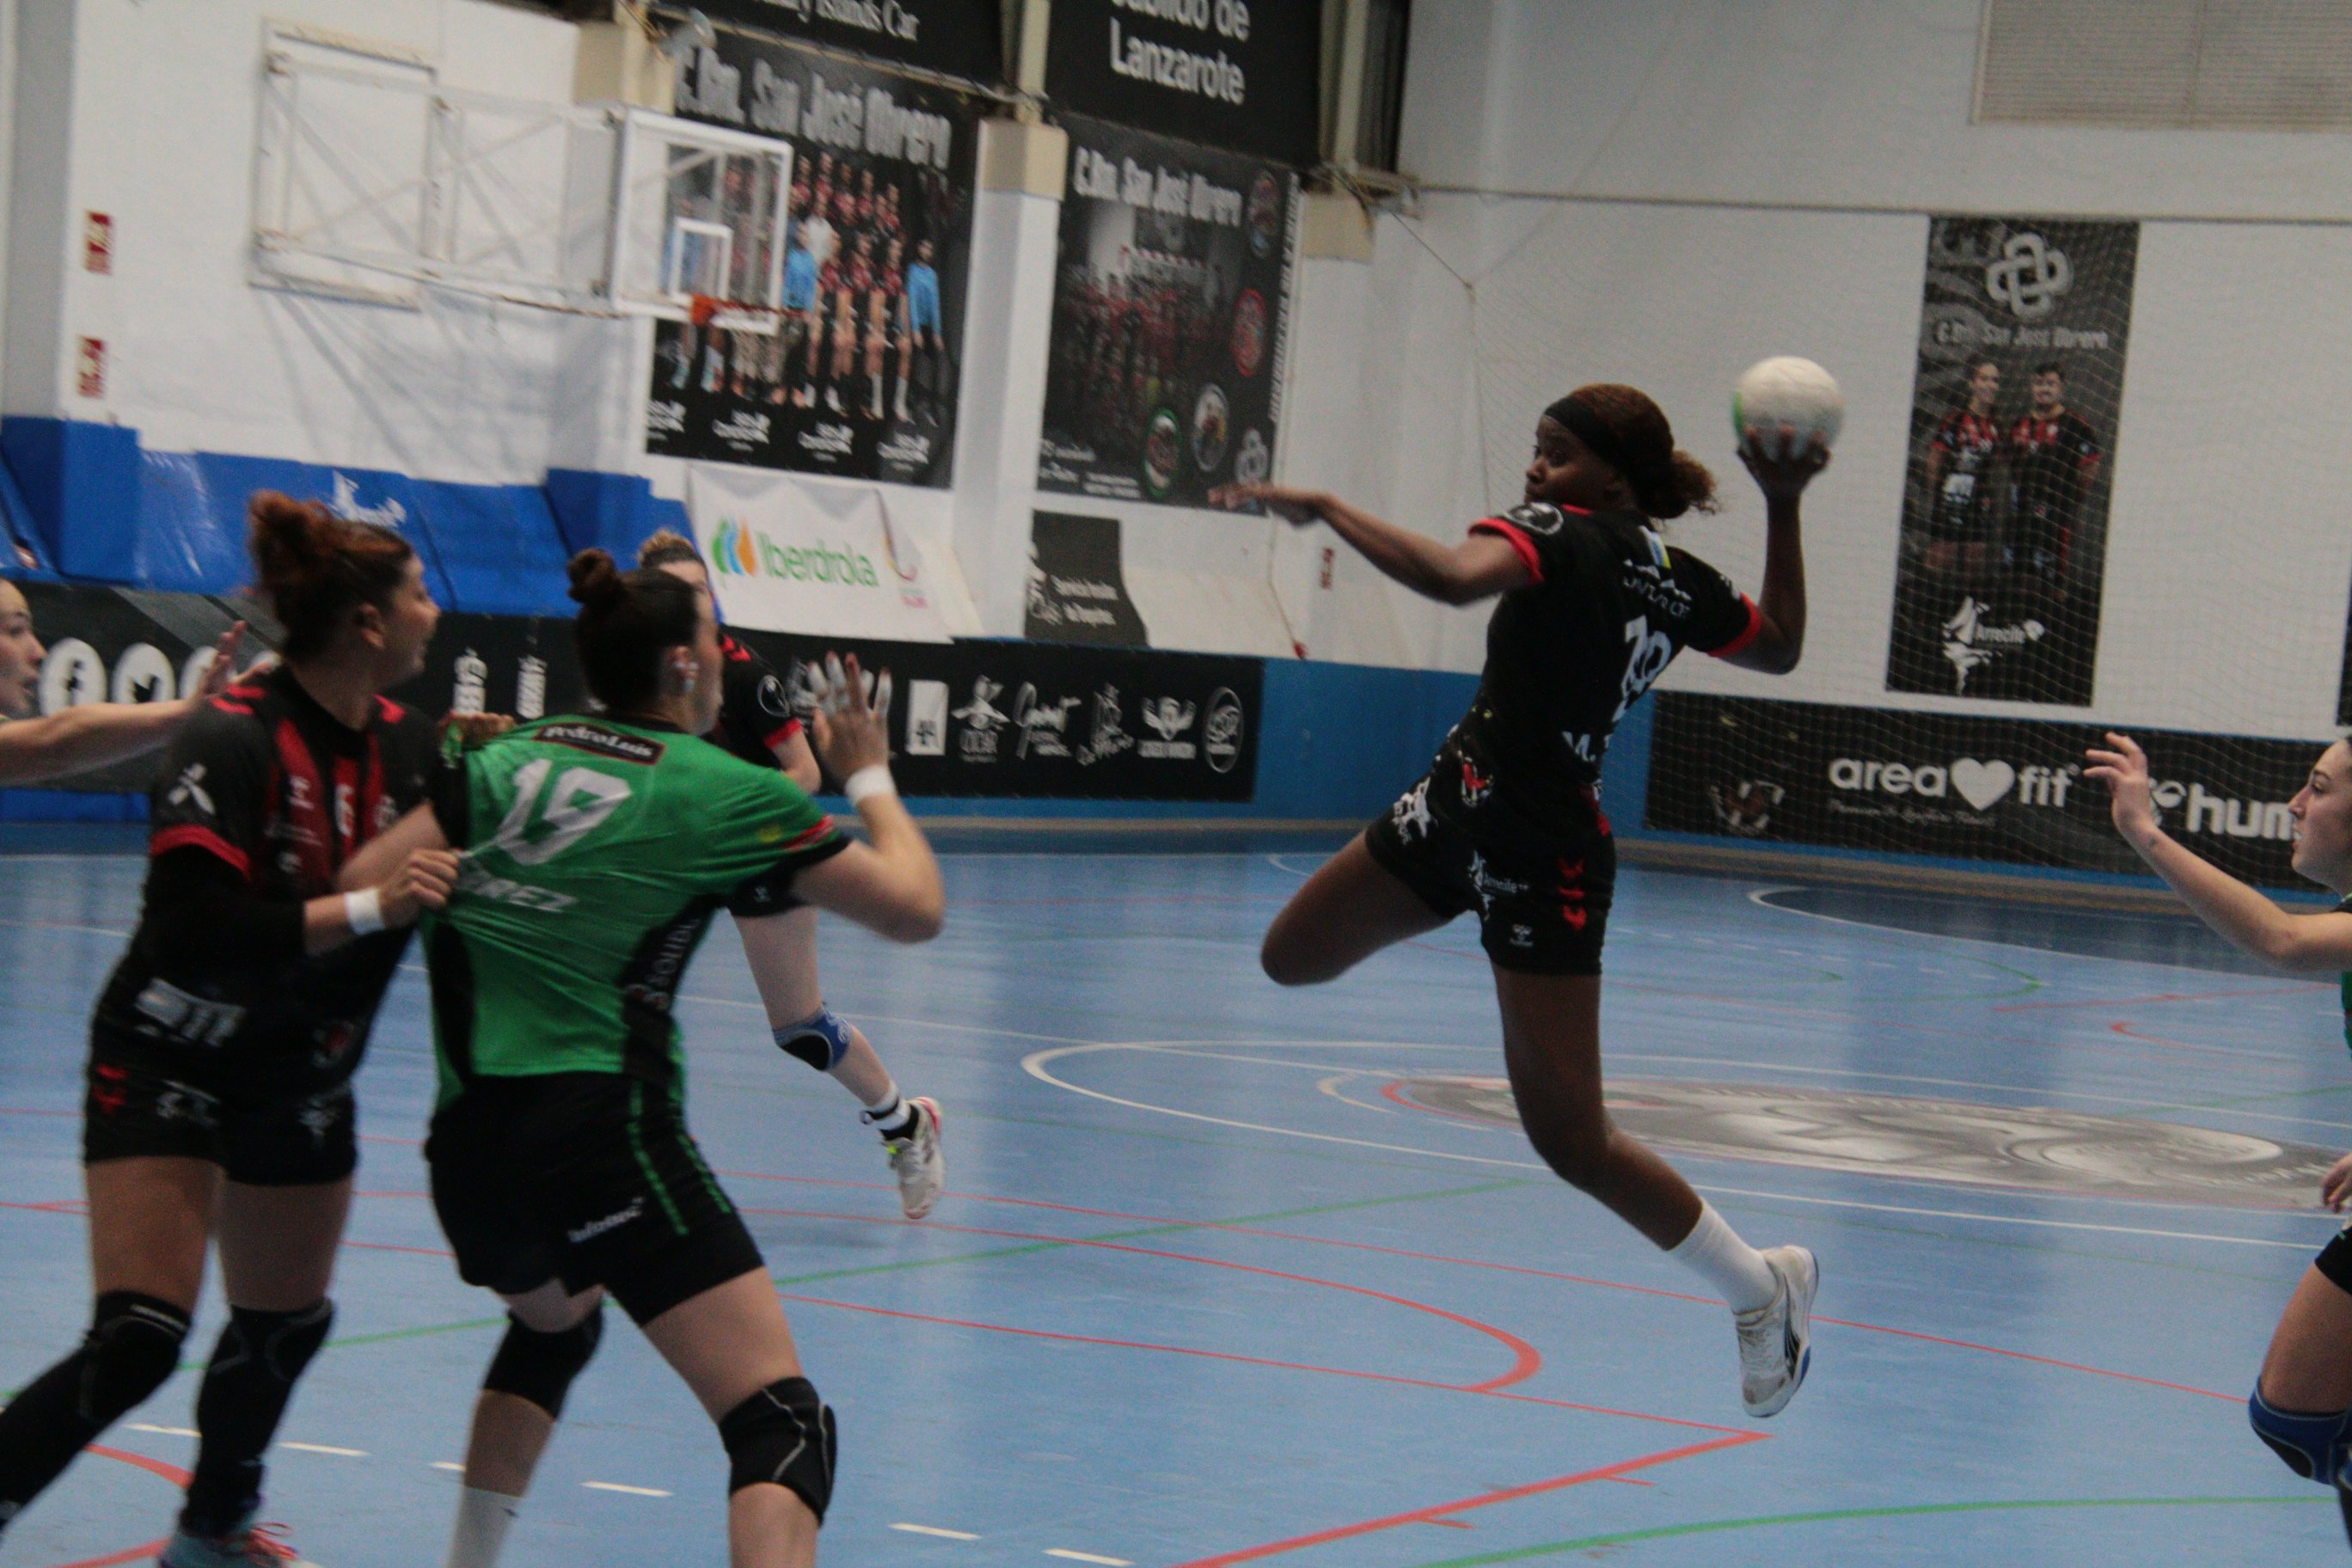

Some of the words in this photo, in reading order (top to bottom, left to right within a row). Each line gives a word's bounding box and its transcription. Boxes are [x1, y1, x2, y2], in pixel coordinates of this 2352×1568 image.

[1110, 15, 1246, 105] Lanzarote
[755, 530, 879, 588] Iberdrola
[483, 758, 633, 867] 19
[1828, 757, 1946, 798] area
[2018, 764, 2073, 809] fit
